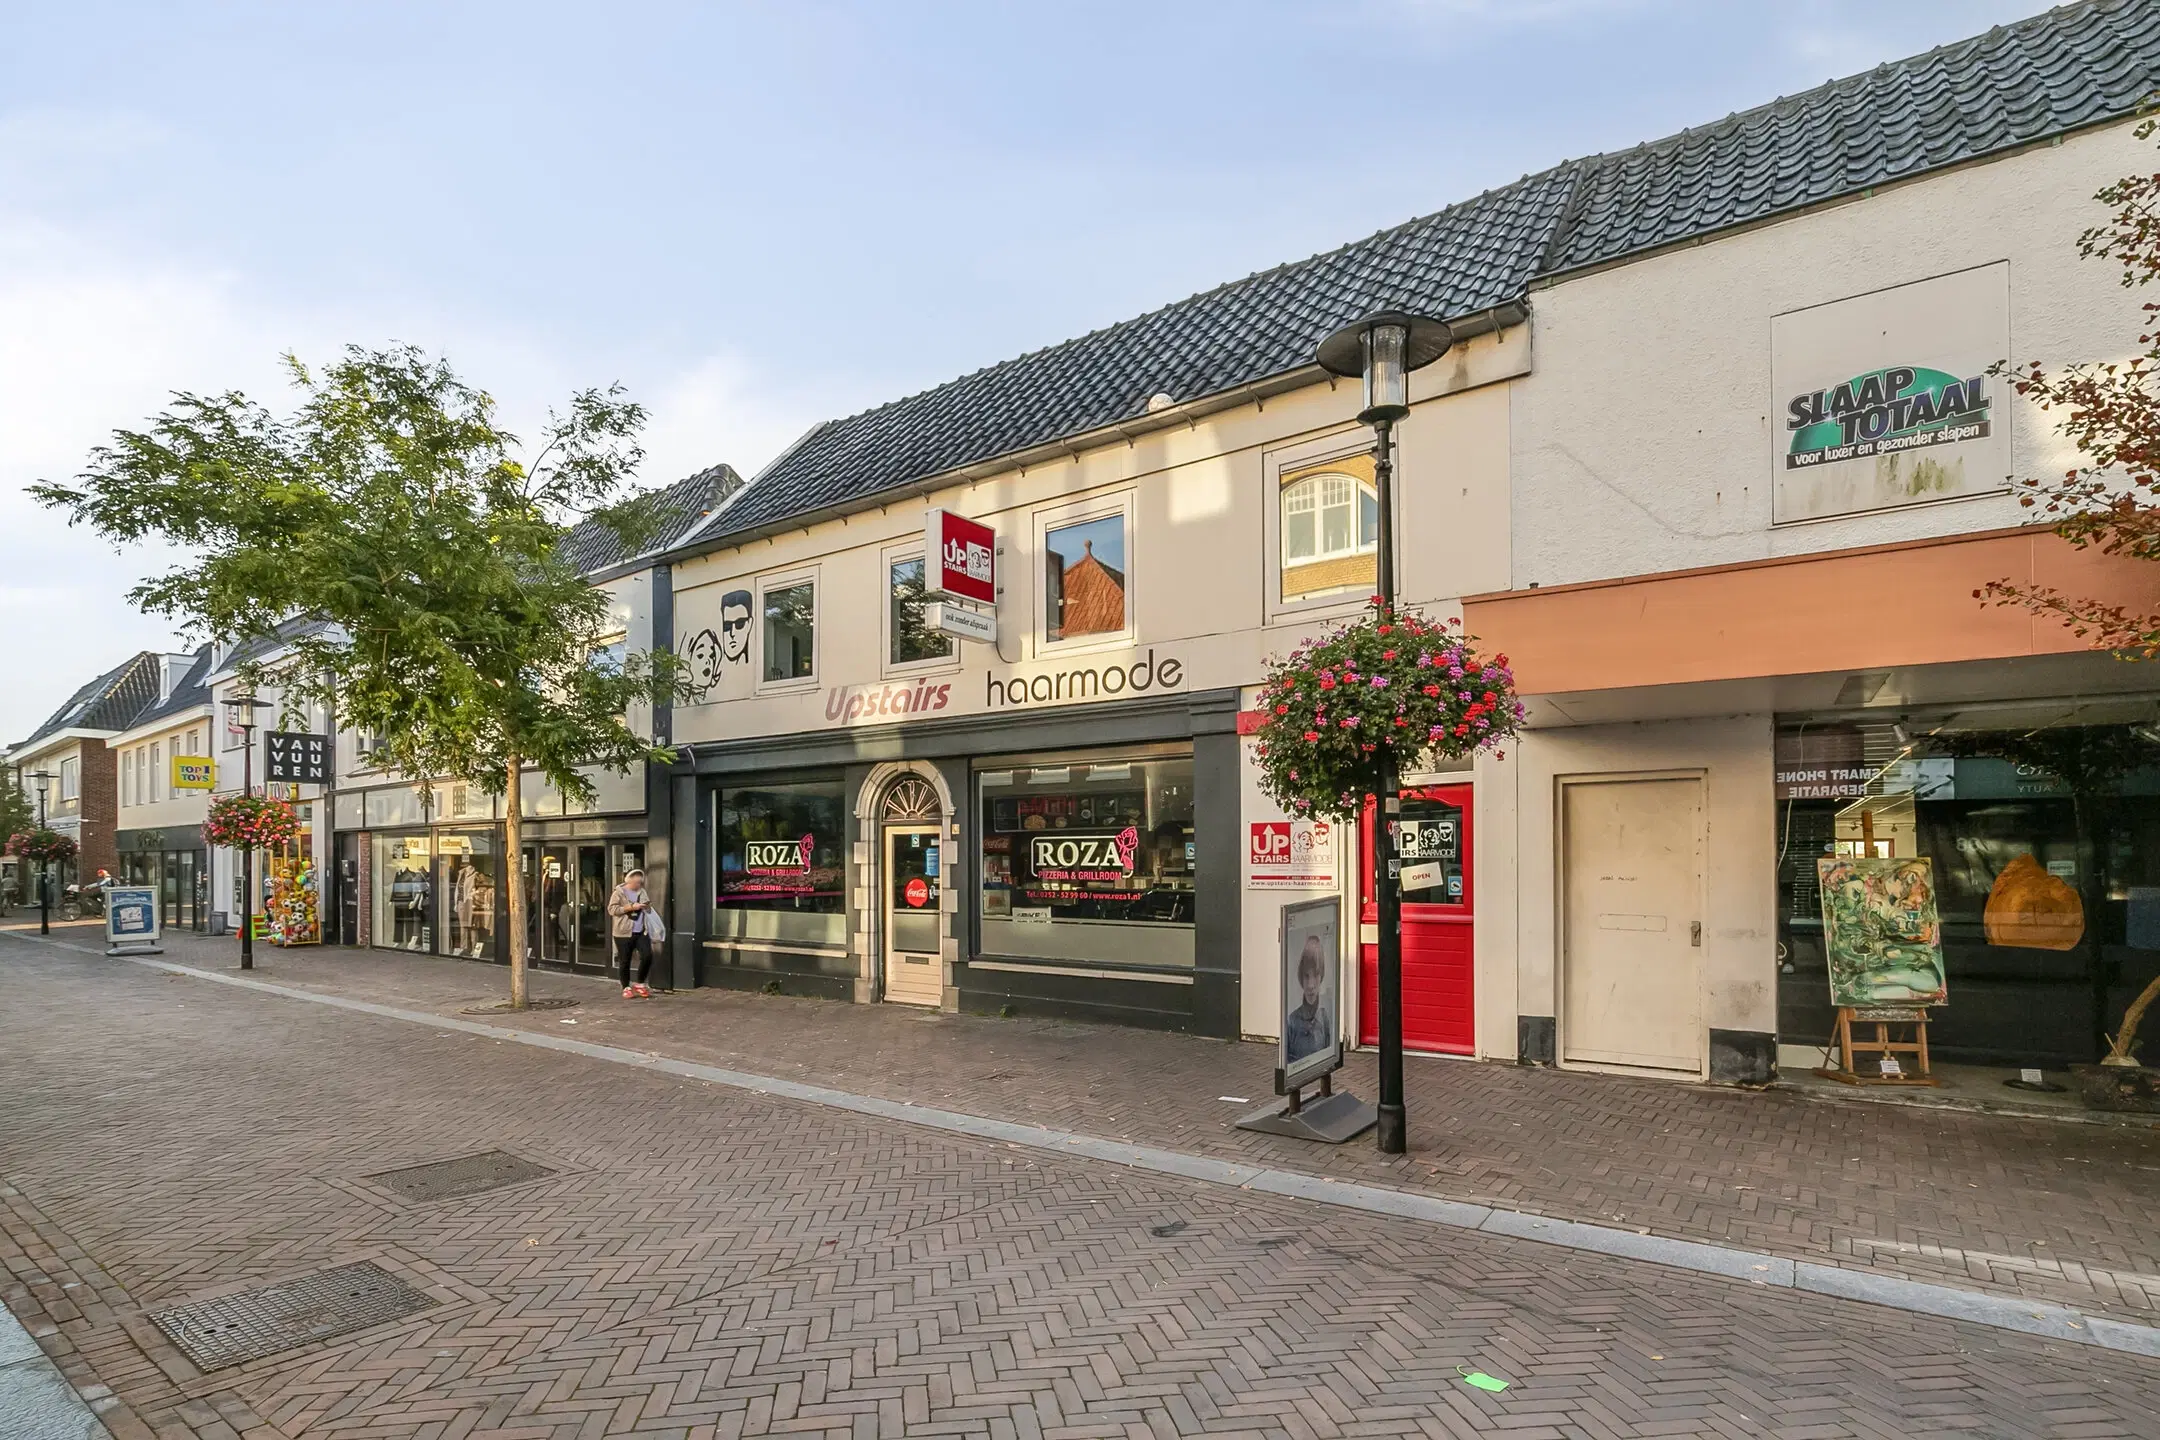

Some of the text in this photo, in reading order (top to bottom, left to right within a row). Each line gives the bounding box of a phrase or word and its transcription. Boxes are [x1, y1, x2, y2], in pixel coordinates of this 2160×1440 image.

[1788, 367, 1915, 430] SLAAP
[1837, 375, 1992, 447] TOTAAL
[1795, 424, 1979, 466] voor luxer en gezonder slapen
[944, 538, 966, 565] UP
[944, 561, 967, 575] STAIRS
[825, 649, 1184, 725] Upstairs haarmode
[271, 738, 322, 751] VAN
[181, 774, 209, 782] TOYS
[1252, 824, 1290, 855] UP
[749, 845, 804, 866] ROZA
[1036, 841, 1124, 867] ROZA
[1252, 854, 1290, 864] STAIRS
[1418, 848, 1456, 857] HAARMODE
[1038, 871, 1122, 880] PIZZERIA & GRILLROOM
[1411, 872, 1431, 881] OPEN
